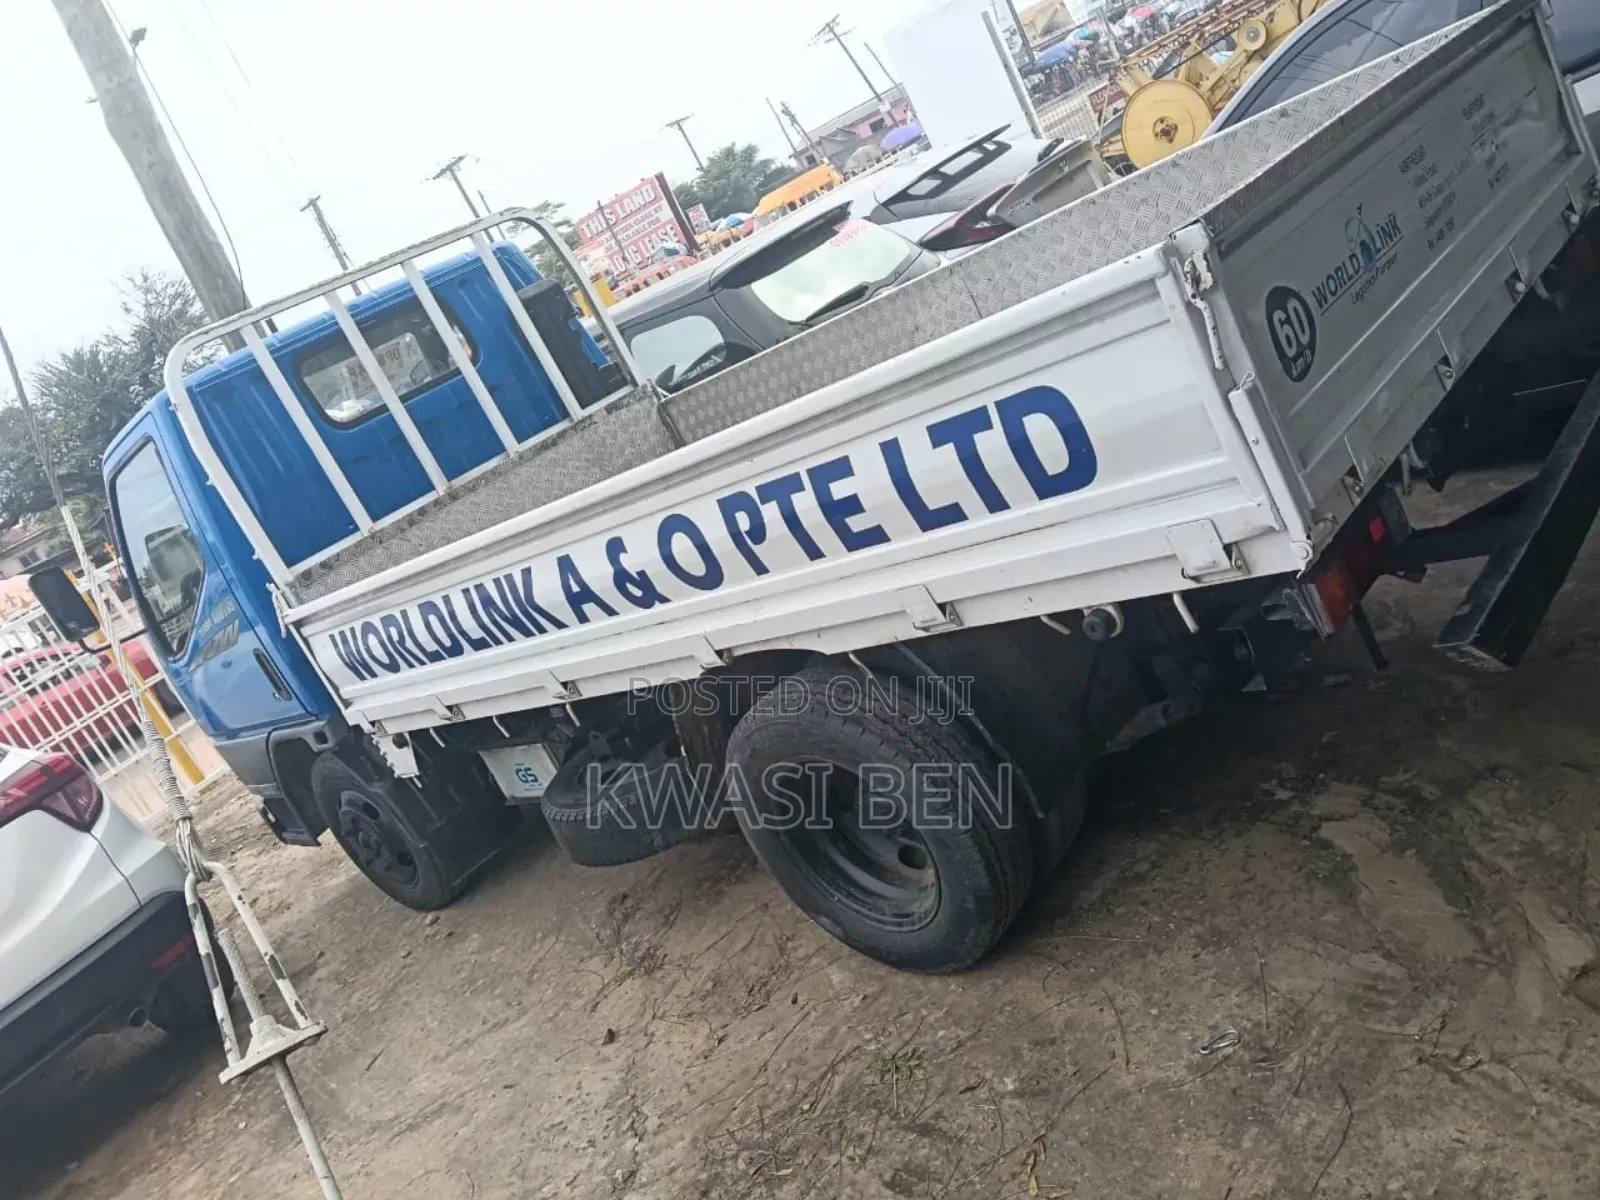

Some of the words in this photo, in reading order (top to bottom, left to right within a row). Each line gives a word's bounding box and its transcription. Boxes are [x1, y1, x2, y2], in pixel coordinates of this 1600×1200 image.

[581, 208, 617, 239] THIS
[615, 183, 656, 220] LAND
[1311, 253, 1361, 311] WORLD
[1273, 297, 1311, 358] 60
[329, 566, 570, 681] WORLDLINK
[557, 554, 611, 625] A
[606, 536, 662, 609] &
[658, 514, 723, 590] O
[718, 457, 888, 575] PTE
[879, 386, 1098, 531] LTD
